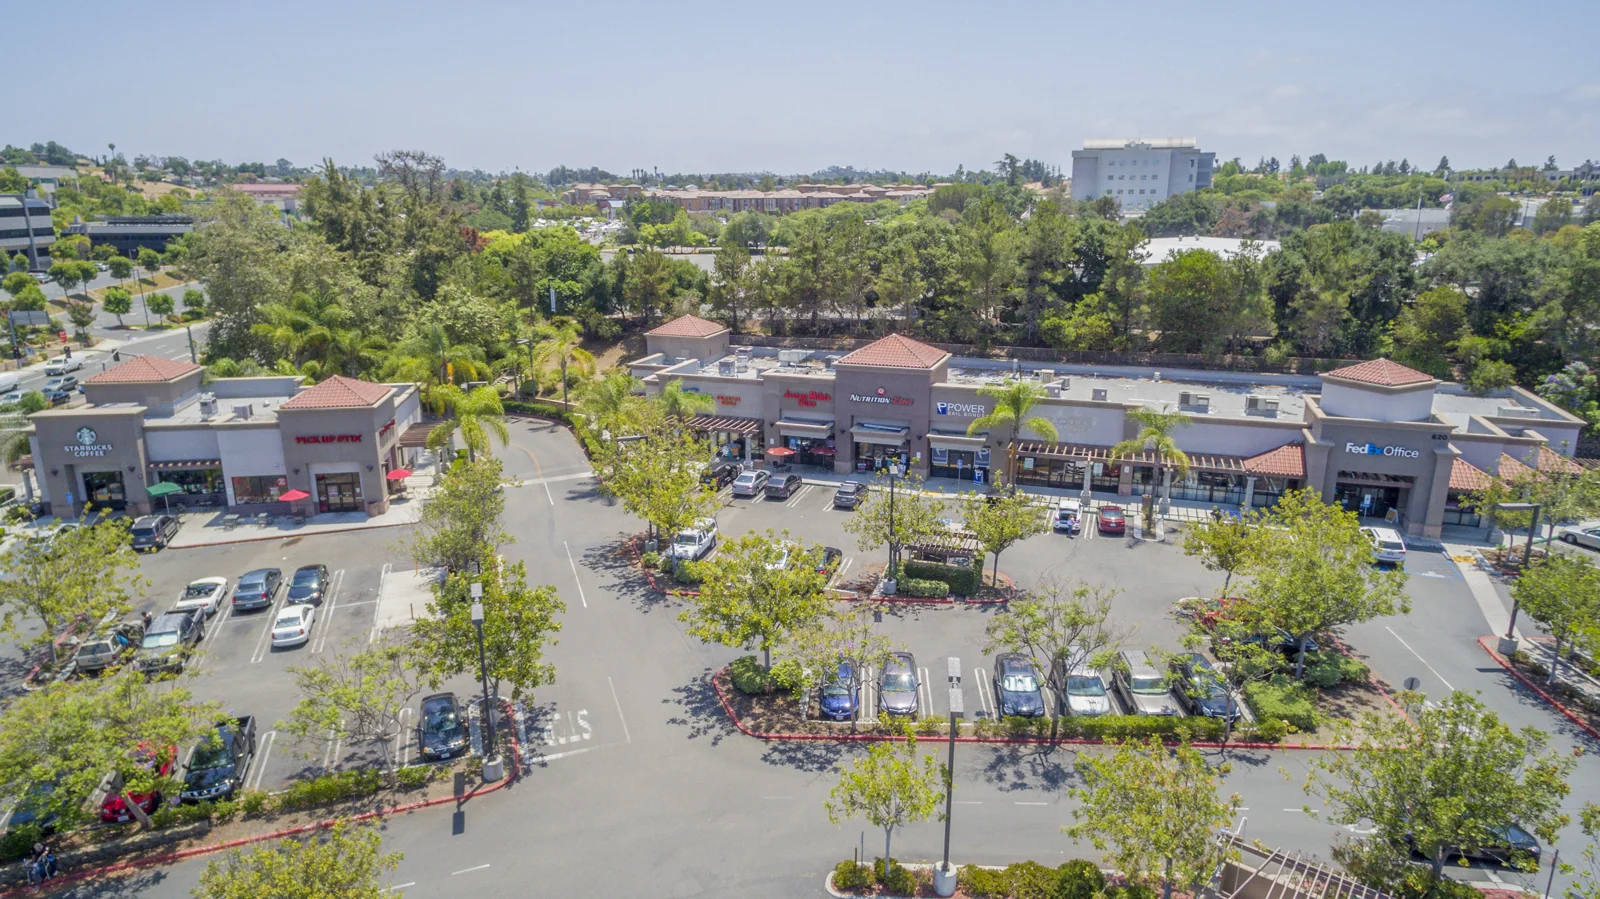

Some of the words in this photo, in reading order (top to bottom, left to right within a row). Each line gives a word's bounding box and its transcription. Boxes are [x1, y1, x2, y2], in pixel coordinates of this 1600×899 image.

[850, 394, 891, 404] NUTRITION
[947, 403, 985, 413] POWER
[64, 444, 112, 452] STARBUCKS
[1345, 442, 1383, 455] FedEx
[1383, 445, 1420, 458] Office
